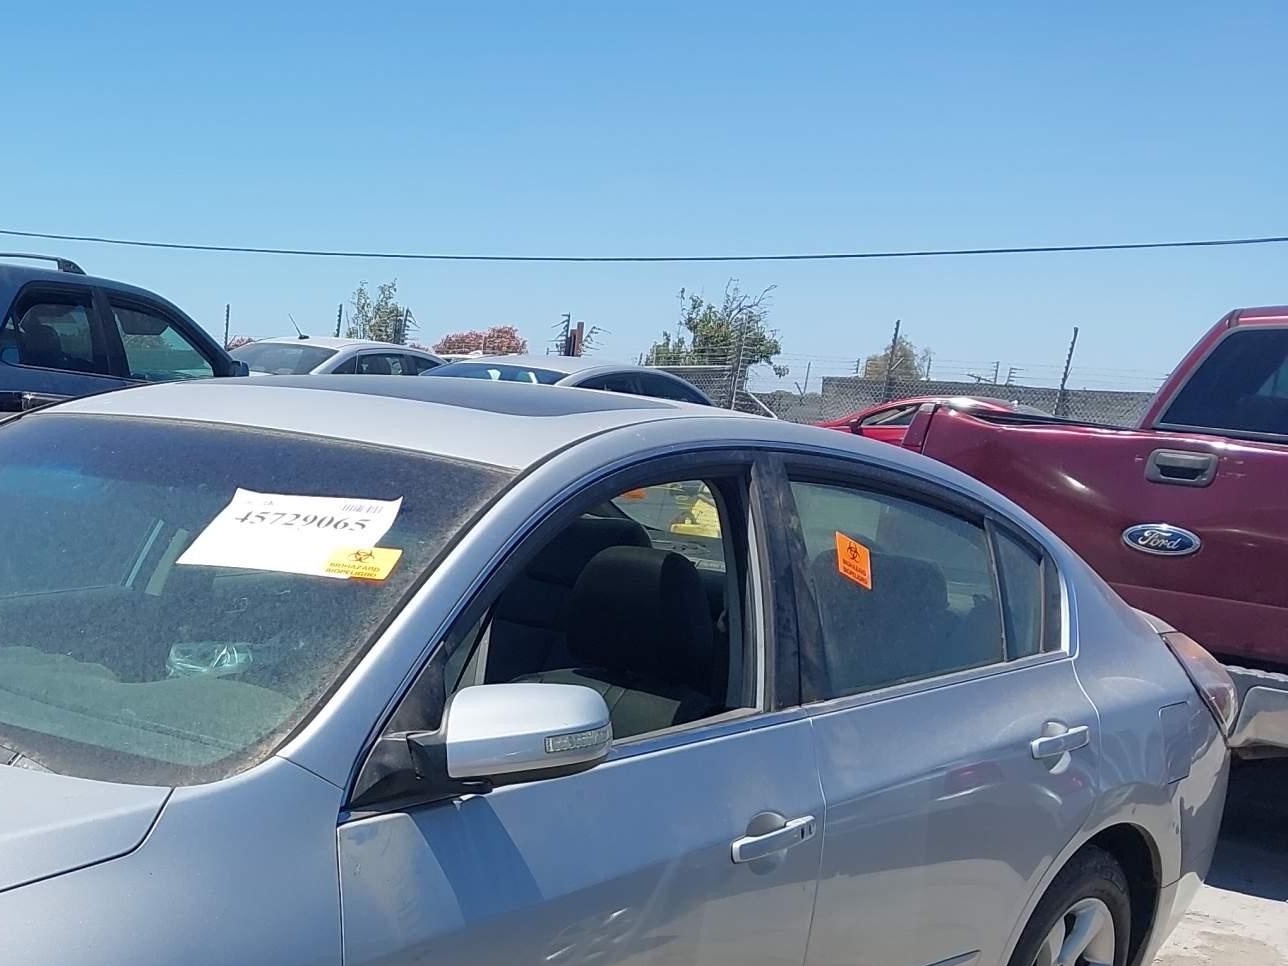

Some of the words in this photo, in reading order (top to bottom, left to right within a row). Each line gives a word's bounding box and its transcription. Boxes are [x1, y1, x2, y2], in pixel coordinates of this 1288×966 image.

[234, 510, 372, 532] 45729065
[1137, 529, 1182, 549] Ford
[329, 562, 381, 573] BIOHAZARD
